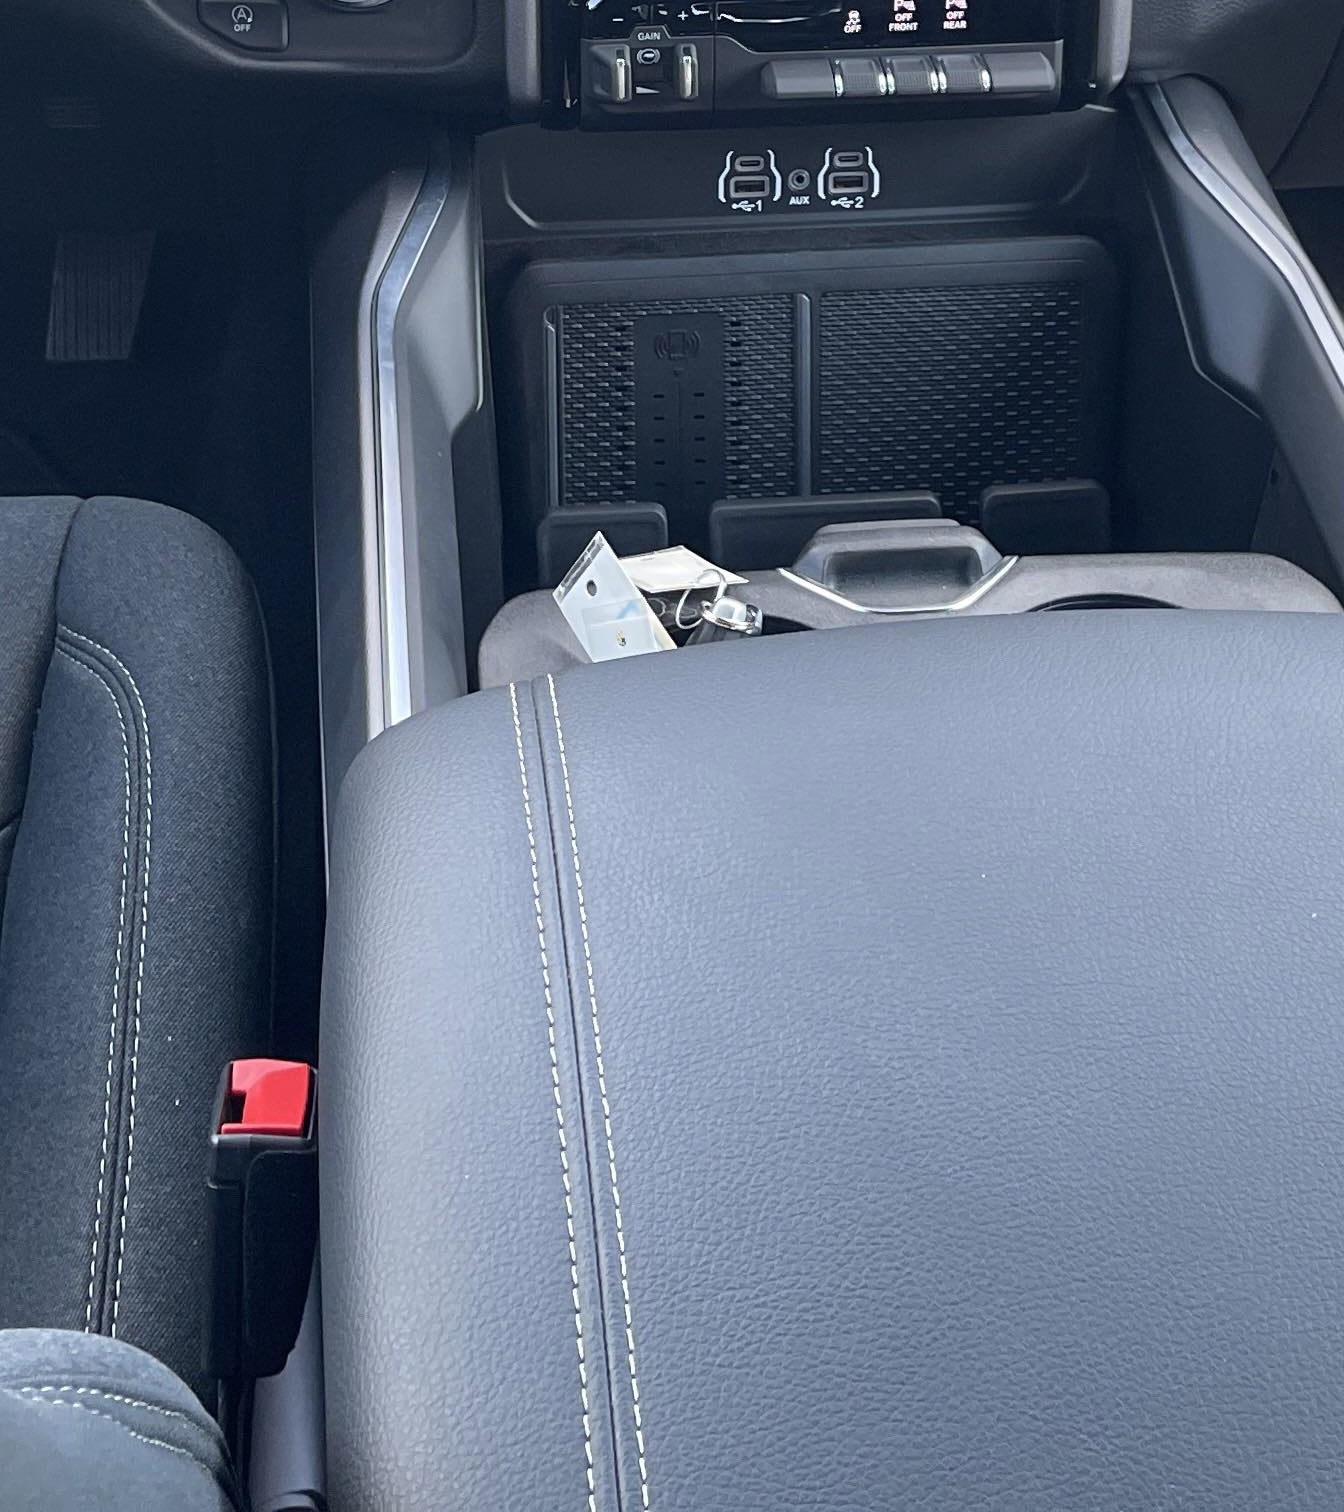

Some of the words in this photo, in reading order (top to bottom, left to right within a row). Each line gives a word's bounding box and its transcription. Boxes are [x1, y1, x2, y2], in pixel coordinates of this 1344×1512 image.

[895, 13, 913, 21] OFF
[946, 11, 965, 19] OFF
[234, 23, 251, 32] OFF
[844, 24, 862, 33] OFF
[888, 22, 918, 31] FRONT
[943, 20, 967, 29] REAR
[637, 32, 661, 41] GAIN
[789, 196, 810, 205] AUX
[855, 197, 864, 209] 2
[756, 200, 763, 212] 1
